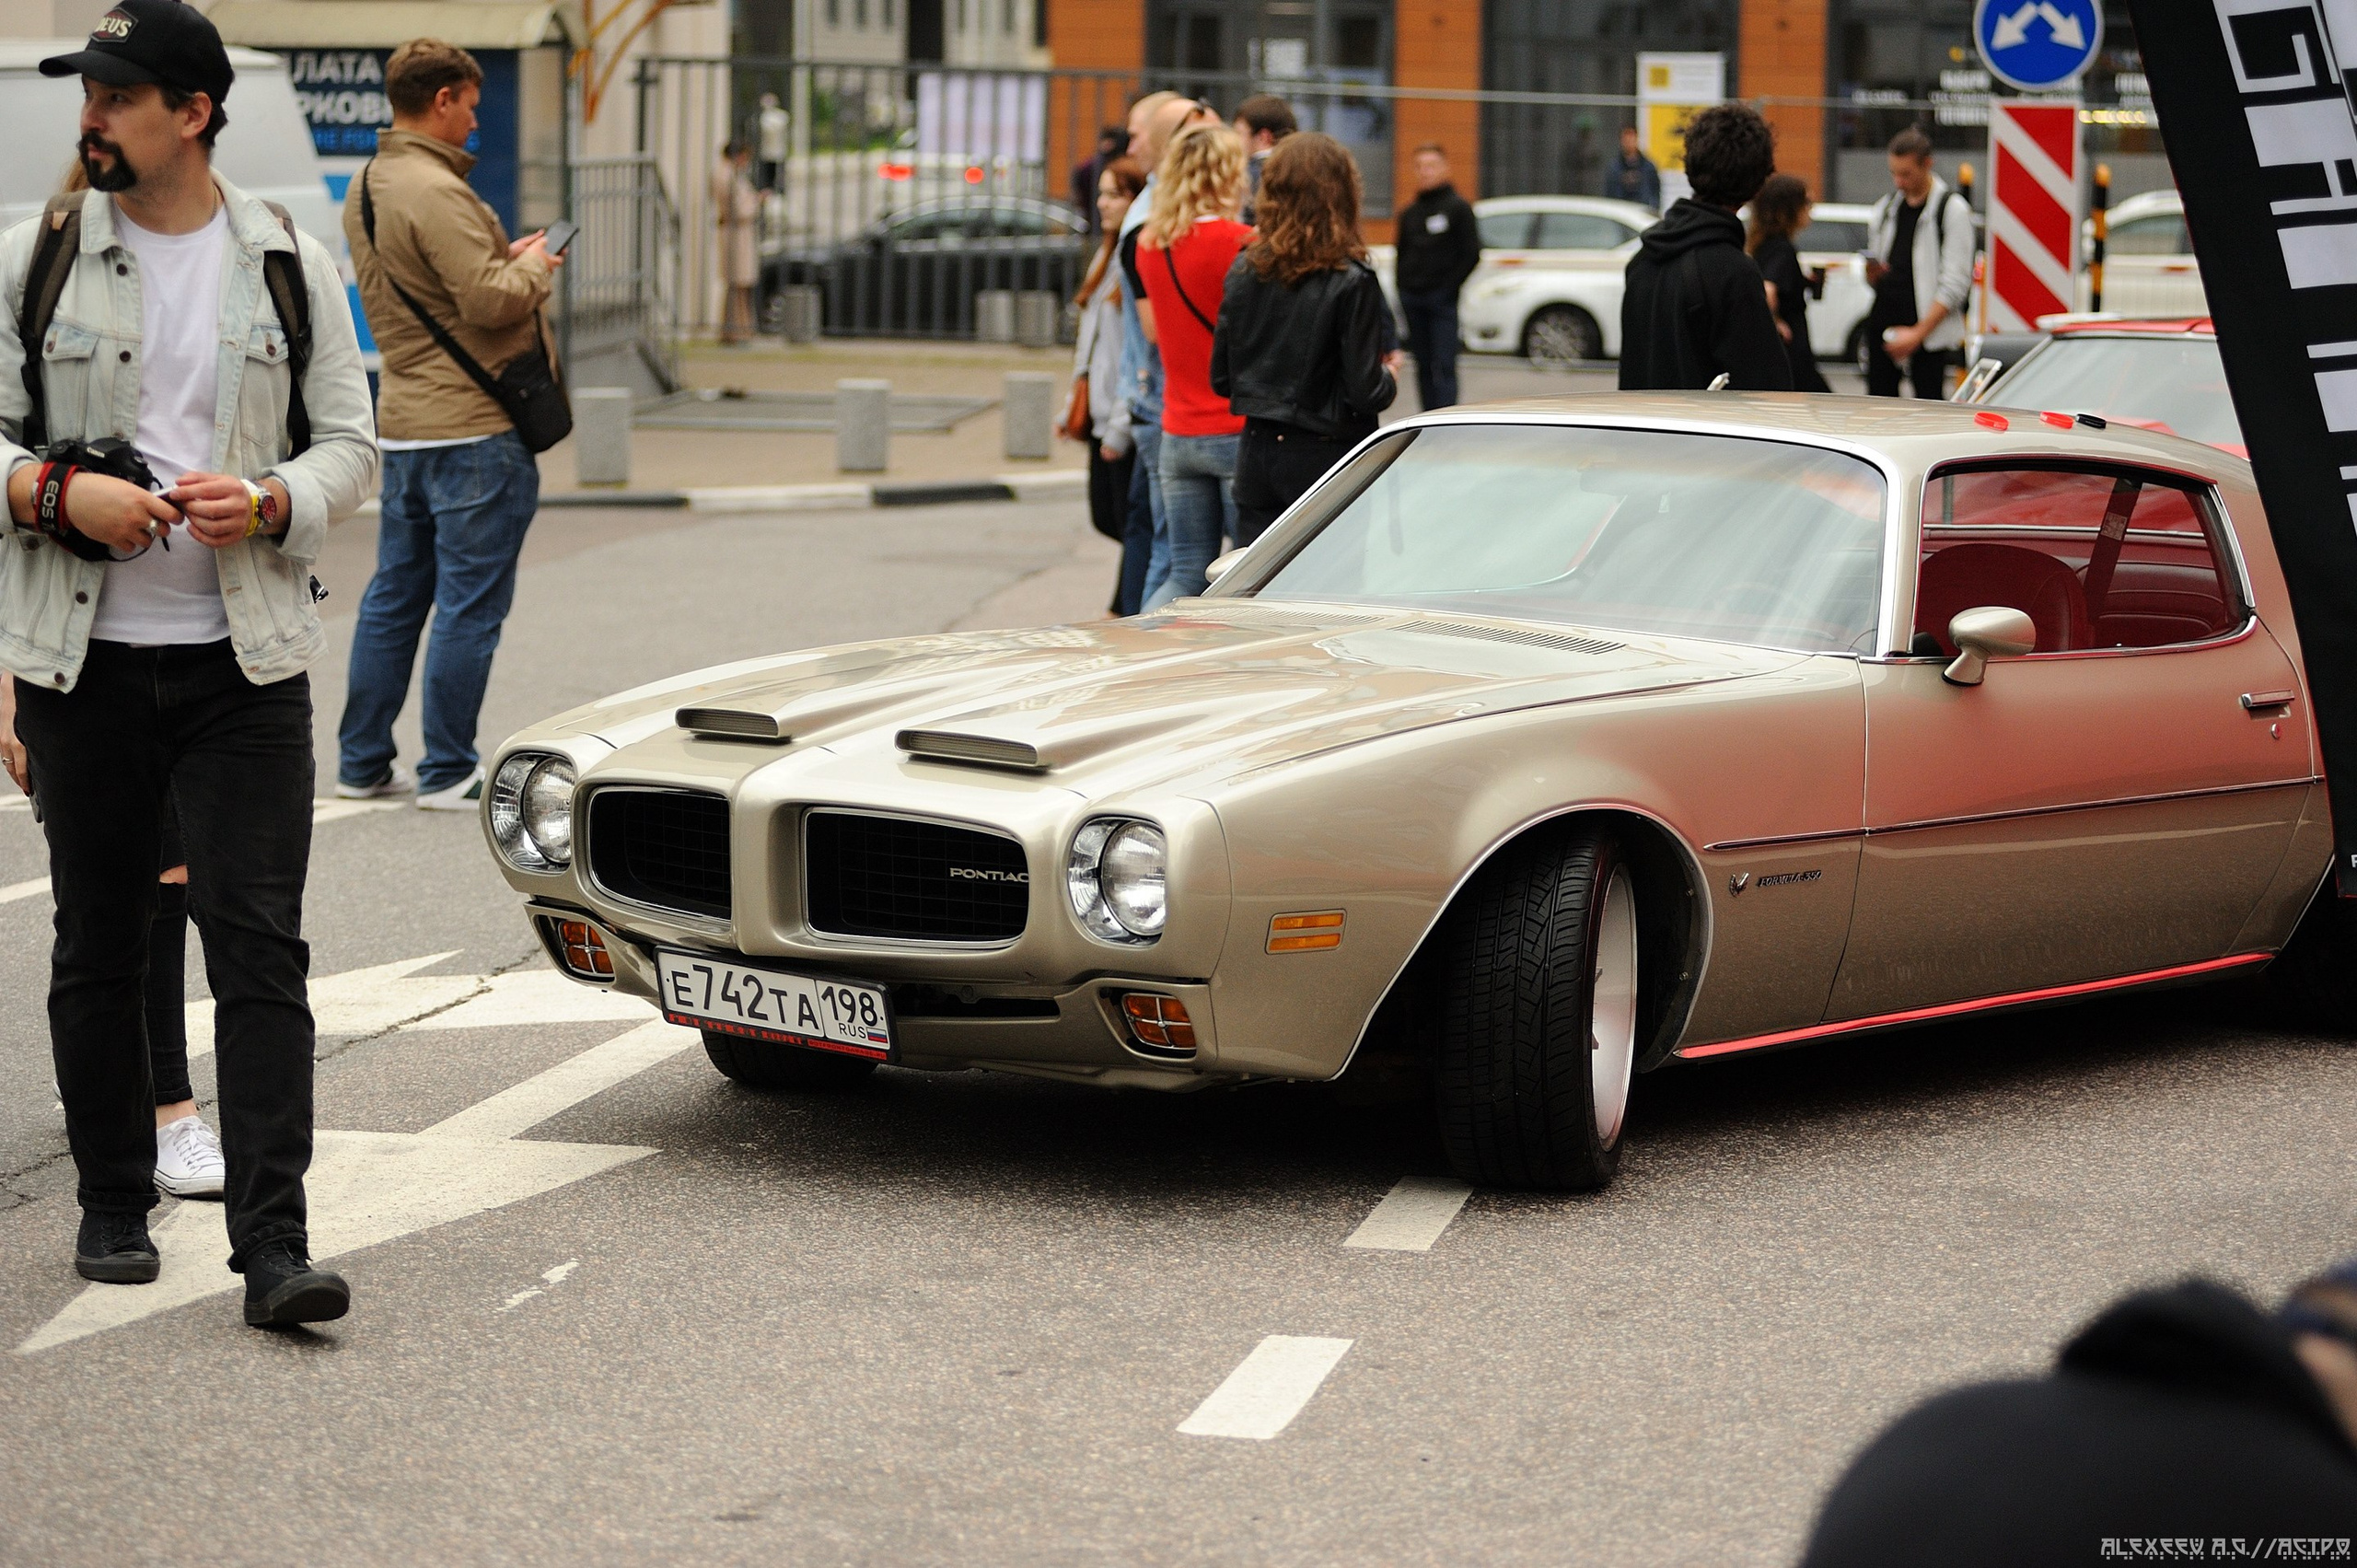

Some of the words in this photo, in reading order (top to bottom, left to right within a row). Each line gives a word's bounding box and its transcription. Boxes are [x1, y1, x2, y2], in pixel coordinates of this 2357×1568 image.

[41, 481, 59, 518] EOS
[949, 867, 1029, 883] PONTIAC
[821, 985, 878, 1027] 198
[838, 1023, 866, 1039] RUS
